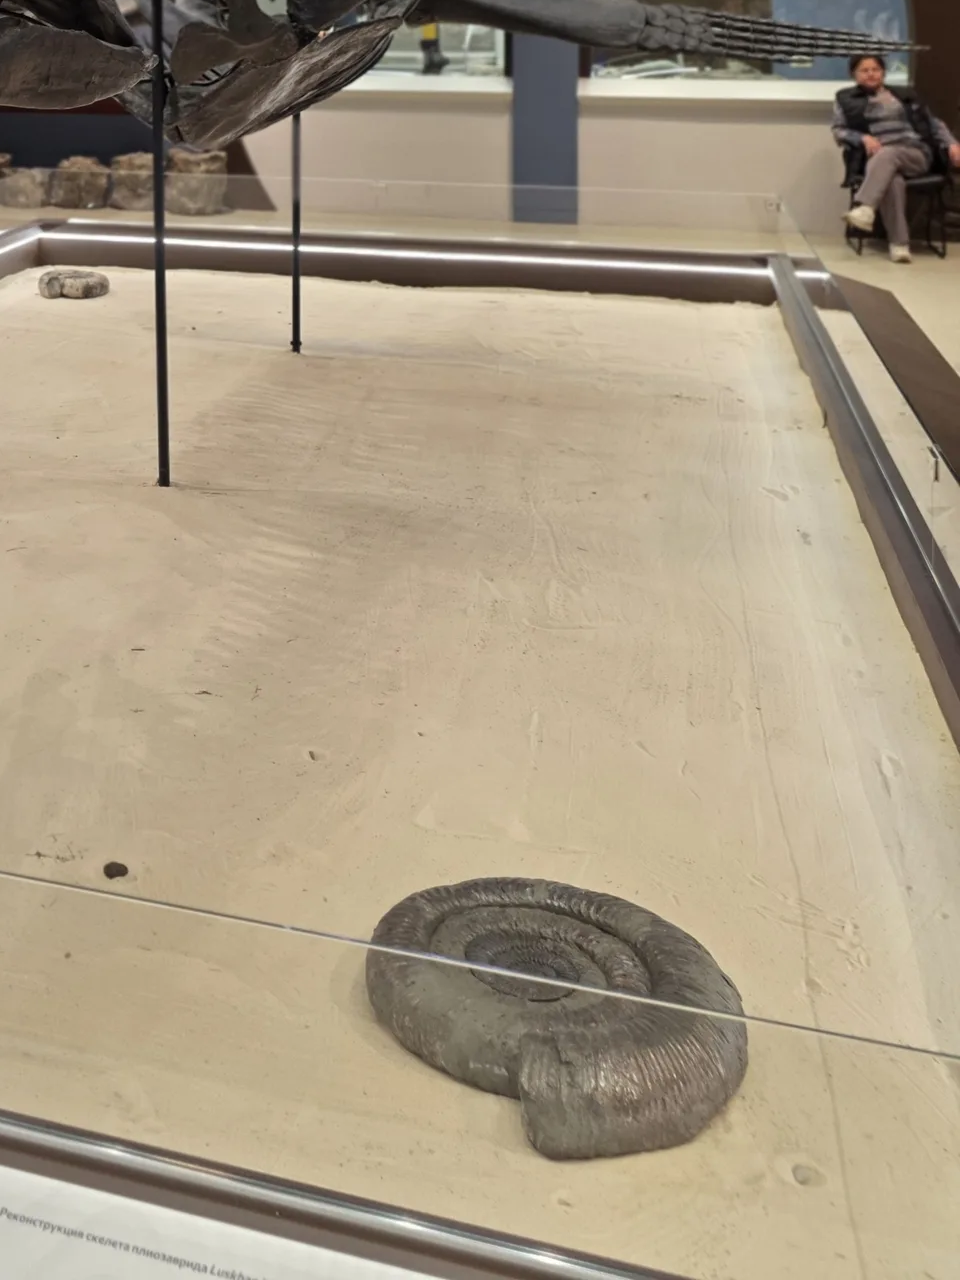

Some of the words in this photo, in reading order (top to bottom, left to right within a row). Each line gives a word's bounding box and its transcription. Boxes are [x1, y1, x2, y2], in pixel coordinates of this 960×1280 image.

[0, 1206, 84, 1239] Реконструкция
[86, 1232, 130, 1253] скелета
[131, 1245, 208, 1275] плиозаврида
